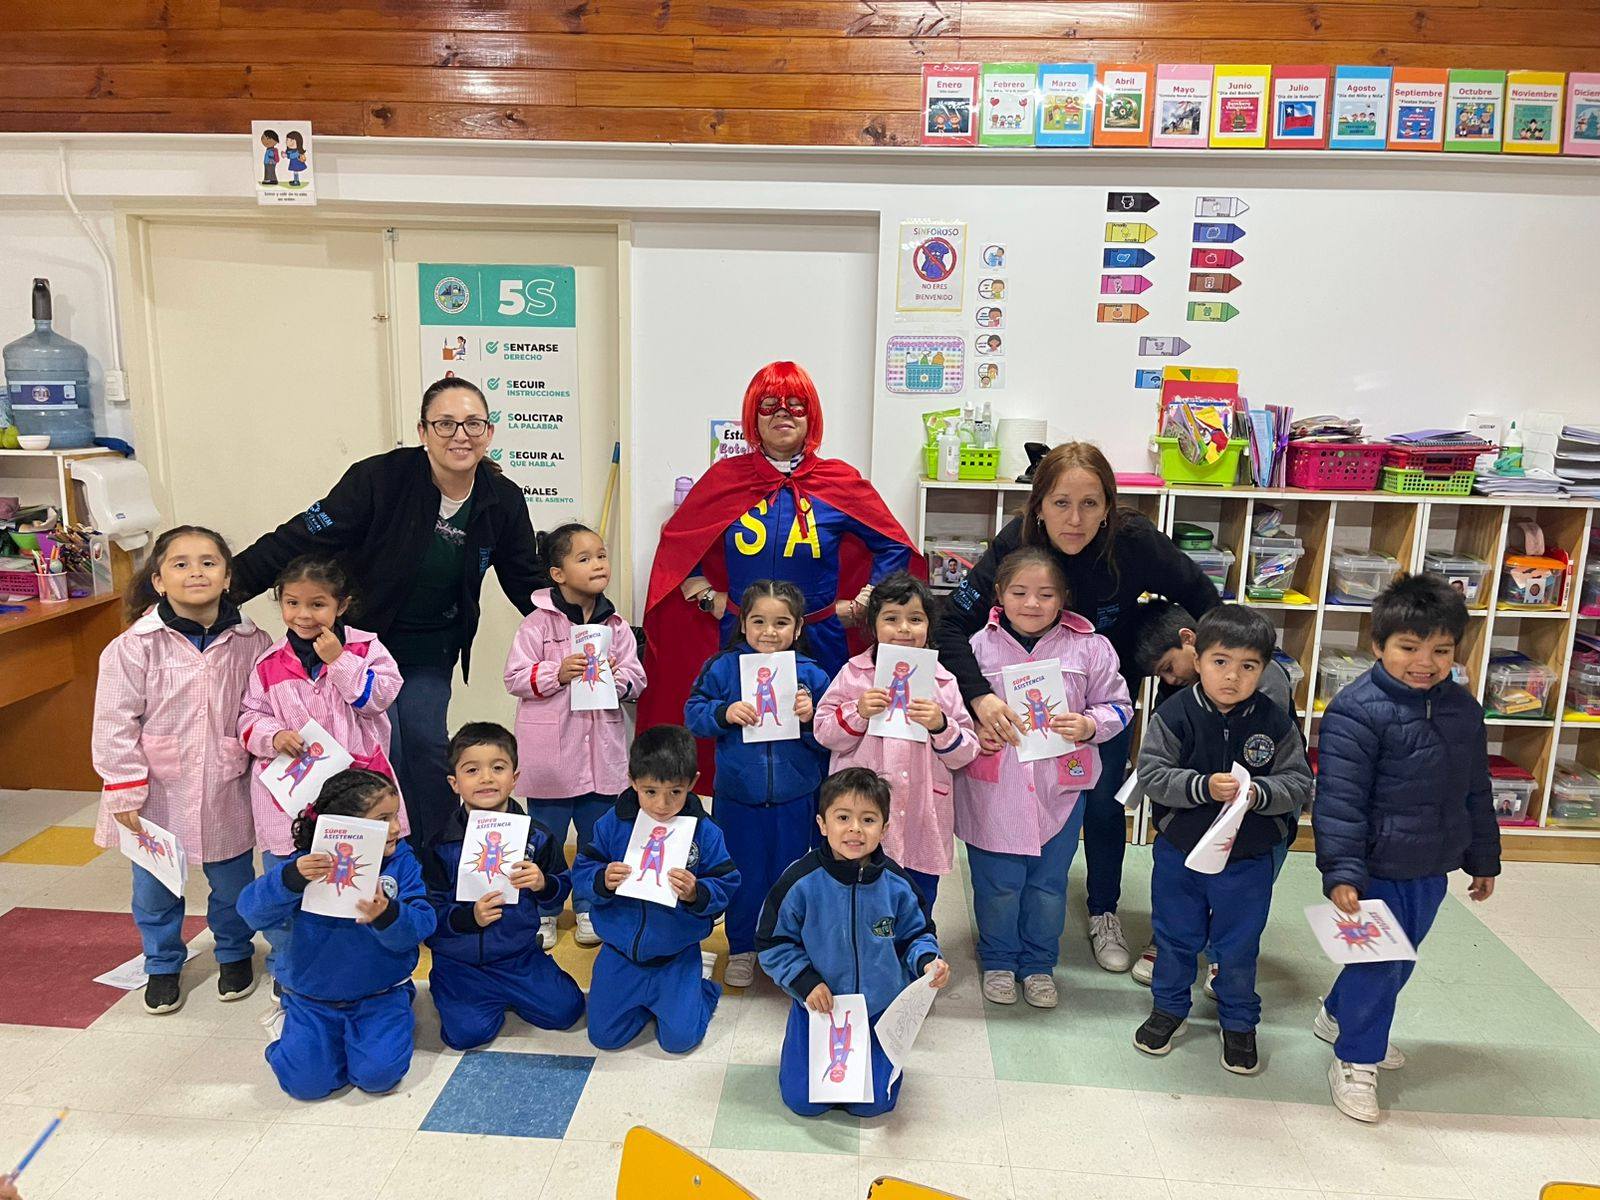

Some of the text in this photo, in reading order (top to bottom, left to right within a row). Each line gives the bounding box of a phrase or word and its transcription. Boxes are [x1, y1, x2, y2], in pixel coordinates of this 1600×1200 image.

[936, 81, 962, 89] Enero
[1228, 82, 1252, 90] Junio
[1288, 84, 1309, 92] Julio
[1347, 84, 1376, 92] Agosto
[1173, 86, 1195, 94] Mayo
[1394, 88, 1443, 98] Septiembre
[1458, 88, 1492, 96] Octubre
[1511, 89, 1558, 98] Noviembre
[913, 227, 959, 236] SINFOROSO
[497, 278, 557, 317] 5S
[915, 293, 953, 301] BIENVENIDO
[503, 342, 559, 352] SENTARSE
[506, 379, 545, 389] SEGUIR
[507, 389, 571, 397] INSTRUCCIONES
[507, 413, 564, 422] SOLICITAR
[509, 451, 565, 460] SEGUIR AL
[510, 460, 526, 468] QUE
[521, 485, 558, 496] ÑALES
[1013, 675, 1045, 691] ASISTENCIA
[476, 822, 512, 830] ASISTENCIA
